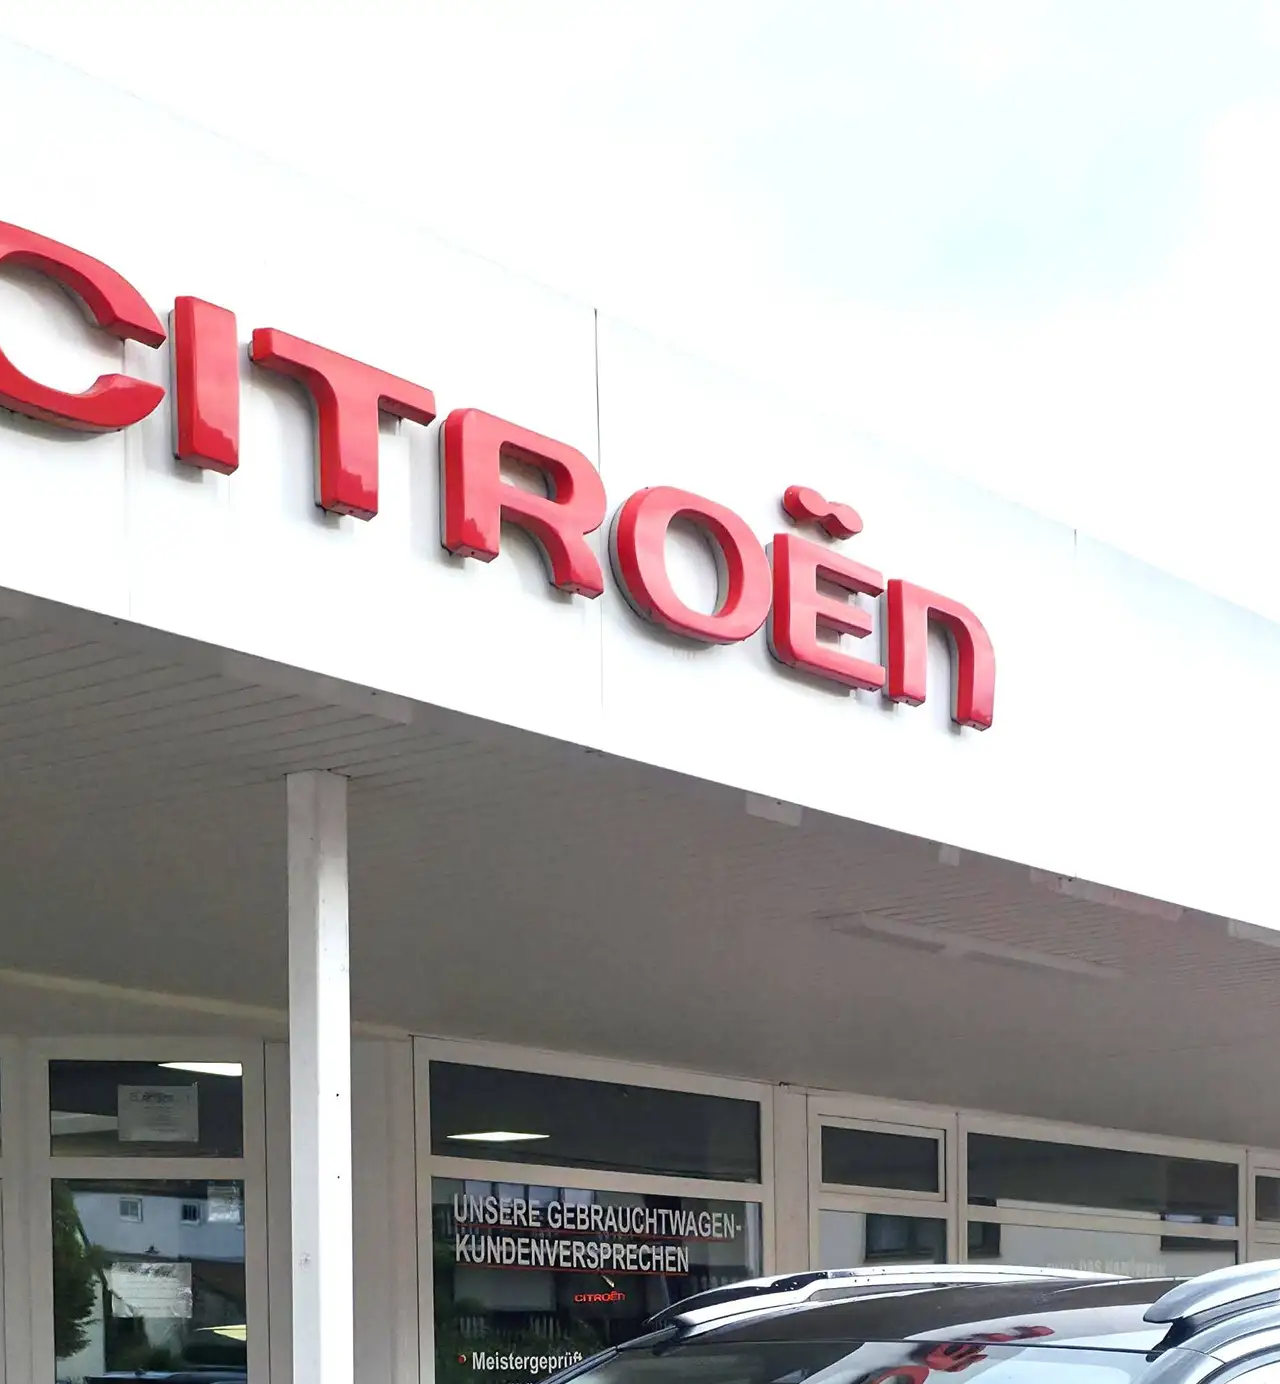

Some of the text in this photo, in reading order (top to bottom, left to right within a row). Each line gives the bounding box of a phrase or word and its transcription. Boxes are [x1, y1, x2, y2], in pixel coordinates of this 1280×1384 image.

[454, 1192, 742, 1239] UNSERE GEBRAUCHTWAGEN-
[455, 1233, 689, 1273] KUNDENVERSPRECHEN
